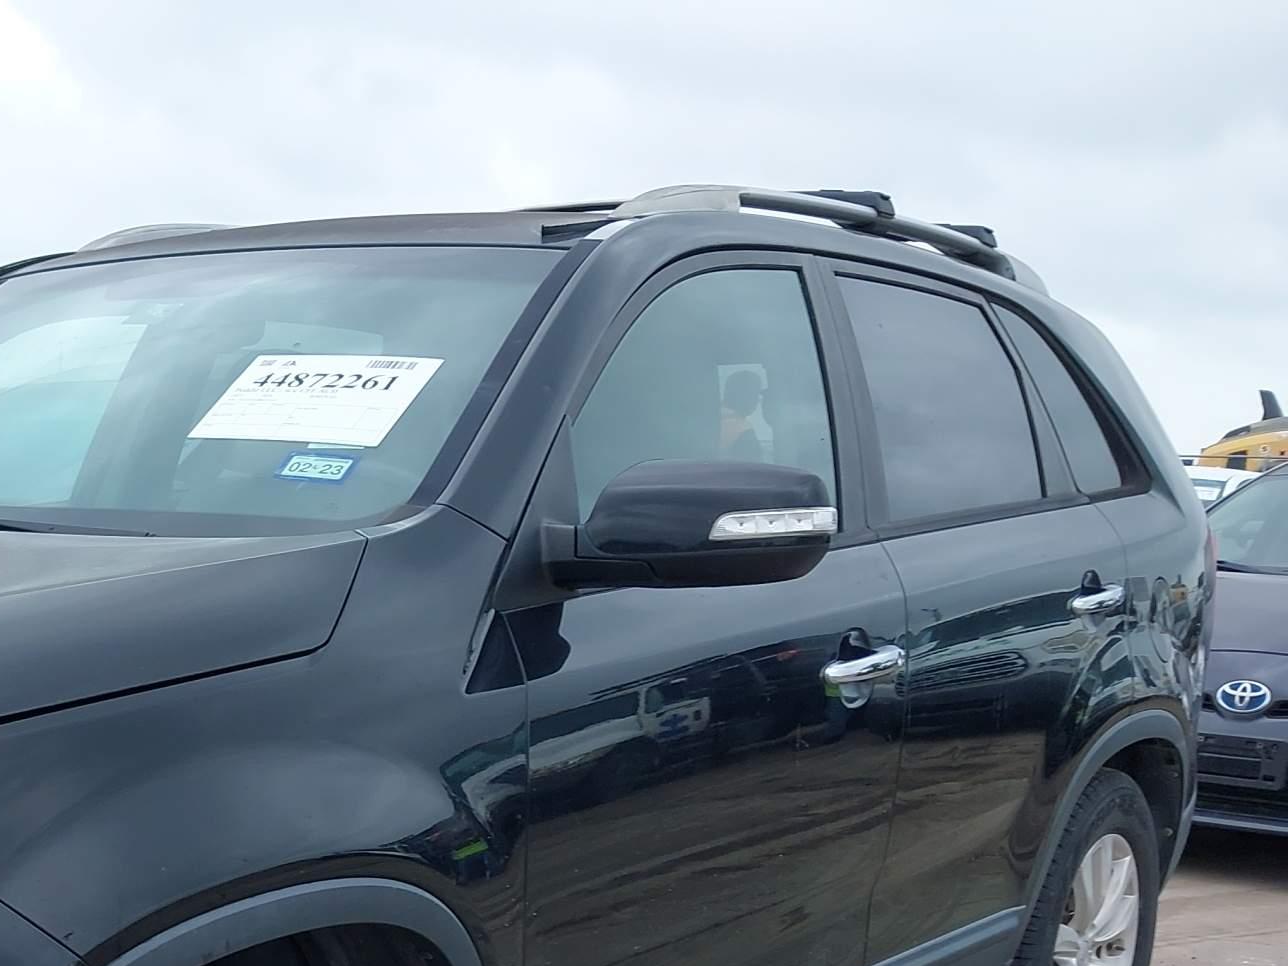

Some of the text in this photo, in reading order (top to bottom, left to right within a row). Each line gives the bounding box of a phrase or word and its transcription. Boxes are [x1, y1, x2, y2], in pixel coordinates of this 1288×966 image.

[253, 372, 399, 390] 44872261
[288, 462, 344, 475] 02 23
